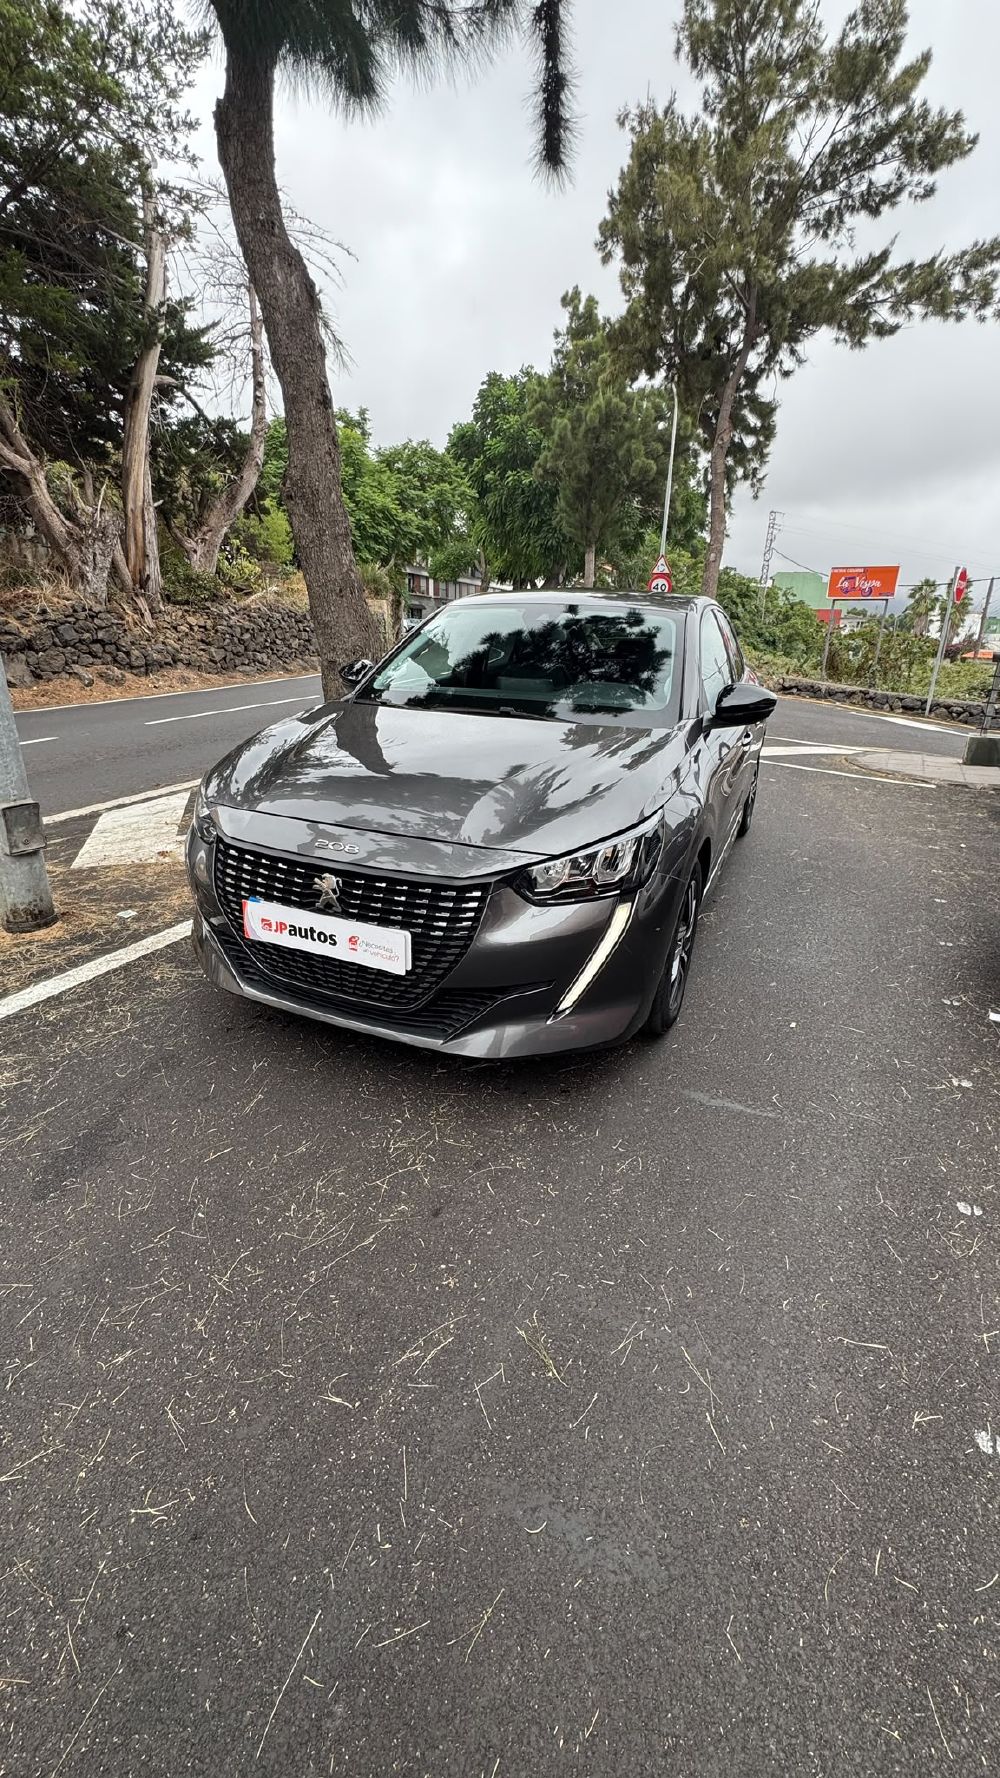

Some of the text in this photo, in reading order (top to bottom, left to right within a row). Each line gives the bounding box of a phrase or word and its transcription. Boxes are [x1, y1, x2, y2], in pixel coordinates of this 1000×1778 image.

[653, 583, 667, 592] 40
[836, 576, 849, 588] La
[314, 839, 360, 855] 208
